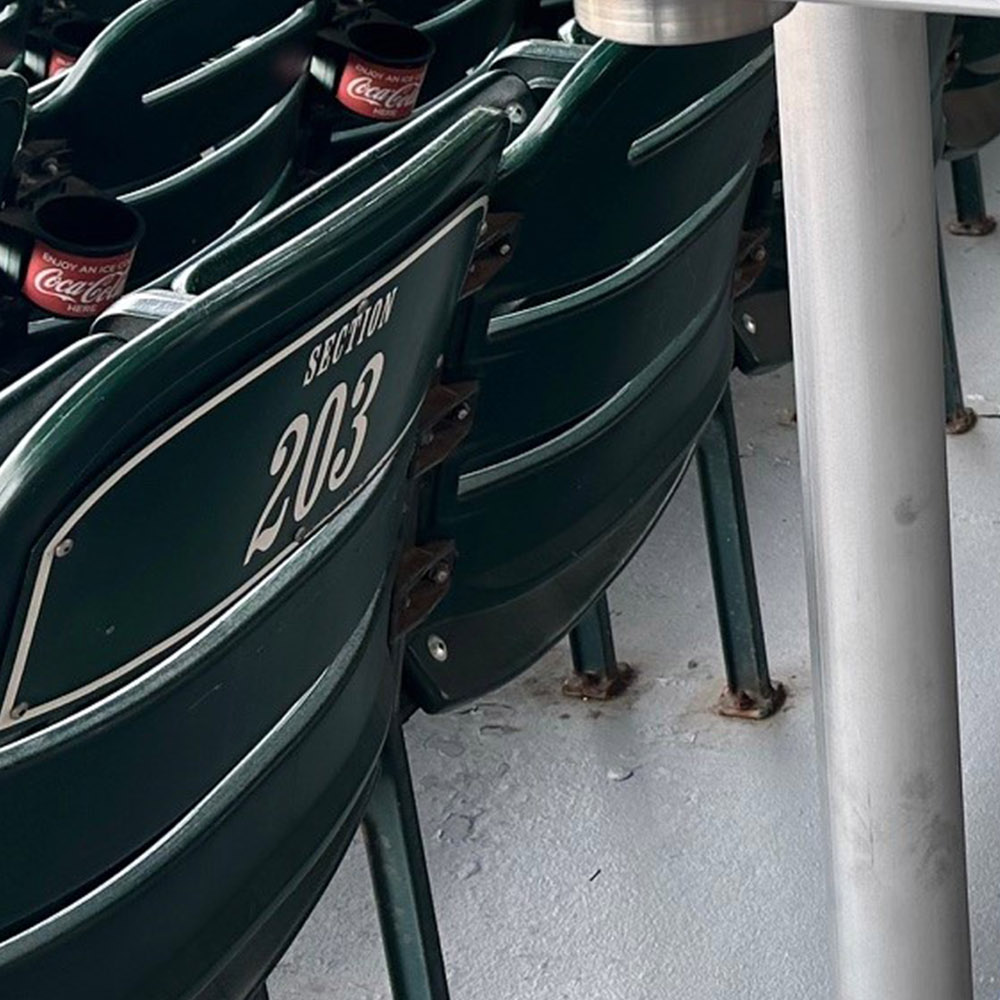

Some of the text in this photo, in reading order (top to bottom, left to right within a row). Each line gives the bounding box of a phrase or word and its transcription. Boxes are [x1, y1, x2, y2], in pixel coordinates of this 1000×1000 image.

[42, 252, 79, 272] ENJOY
[78, 265, 98, 274] AN
[99, 264, 115, 274] ICE
[66, 303, 98, 313] HERE
[302, 286, 399, 388] SECTION
[242, 351, 385, 567] 203
